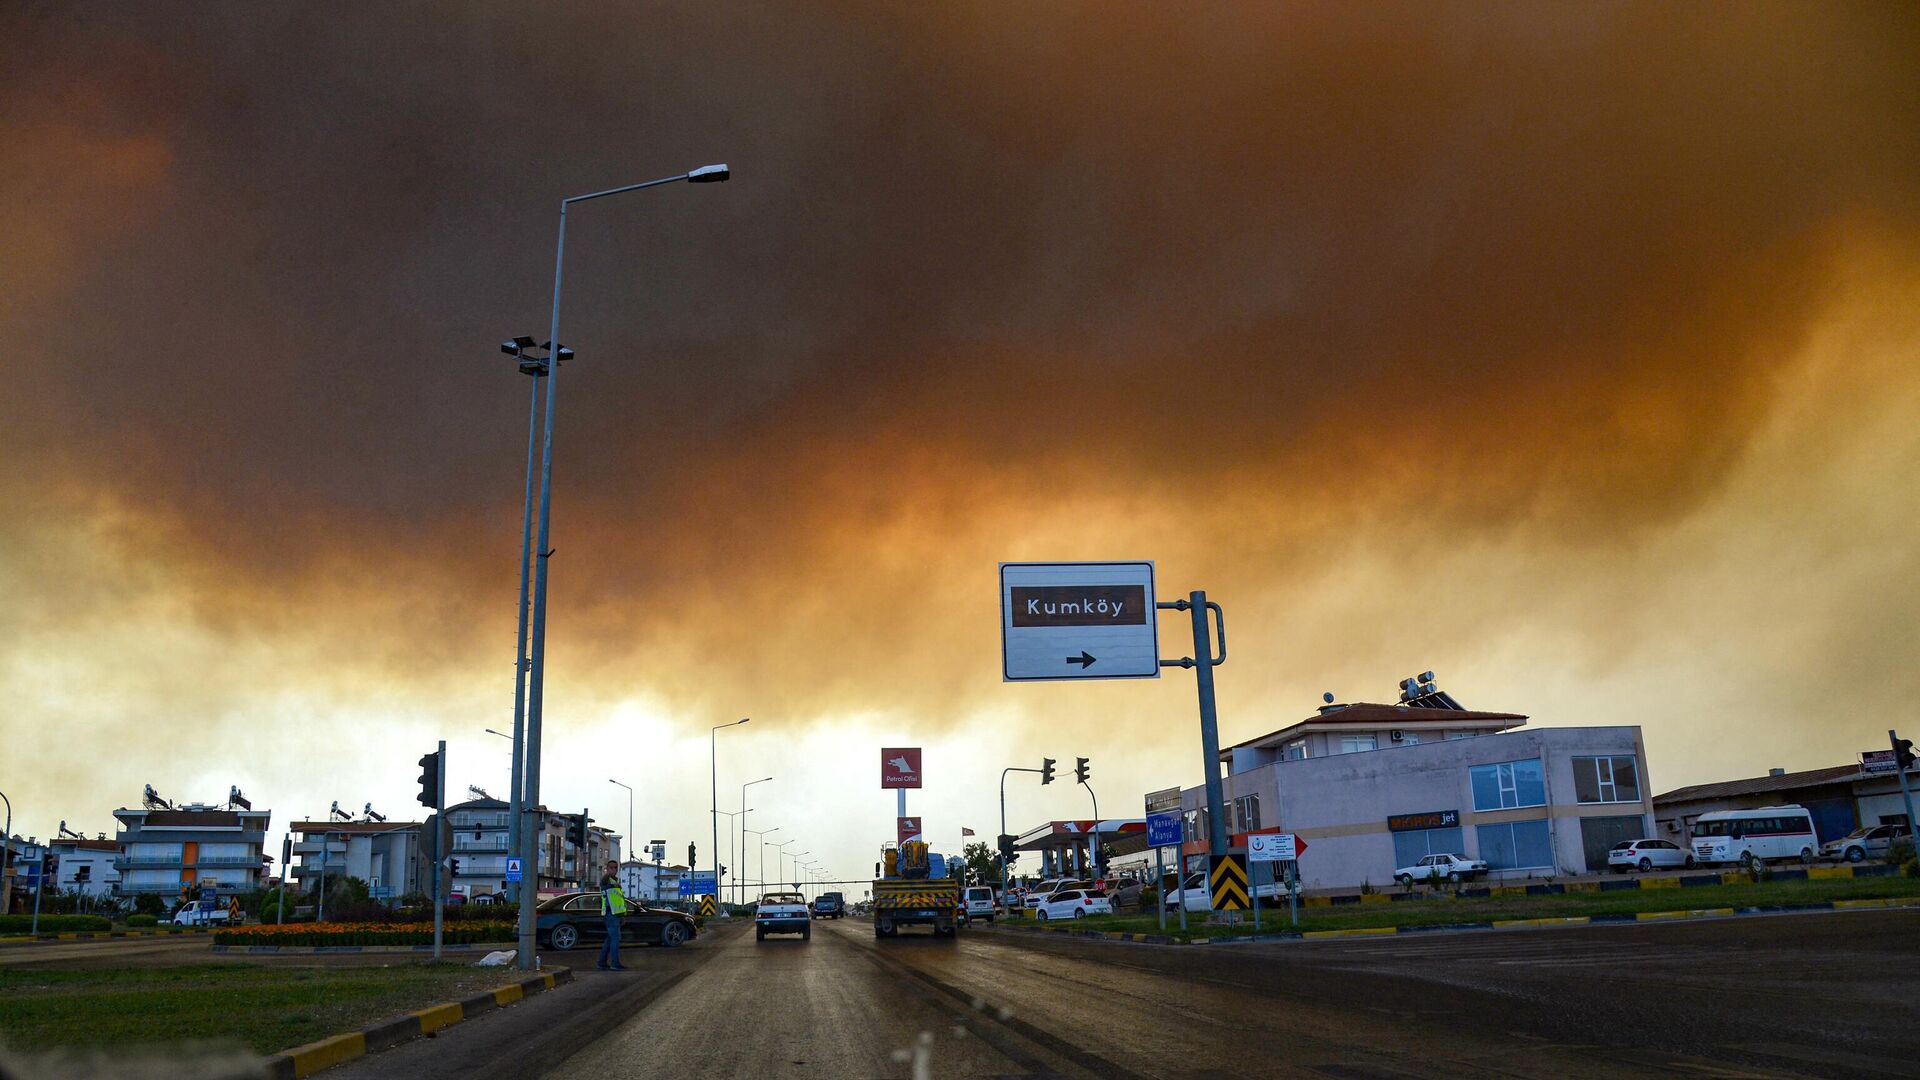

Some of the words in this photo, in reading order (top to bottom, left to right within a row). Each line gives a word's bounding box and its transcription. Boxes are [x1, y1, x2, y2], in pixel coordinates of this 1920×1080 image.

[1027, 598, 1123, 617] Kumköy
[1153, 816, 1180, 829] Manavgat
[1441, 812, 1455, 825] jet
[1154, 830, 1173, 842] Alanya
